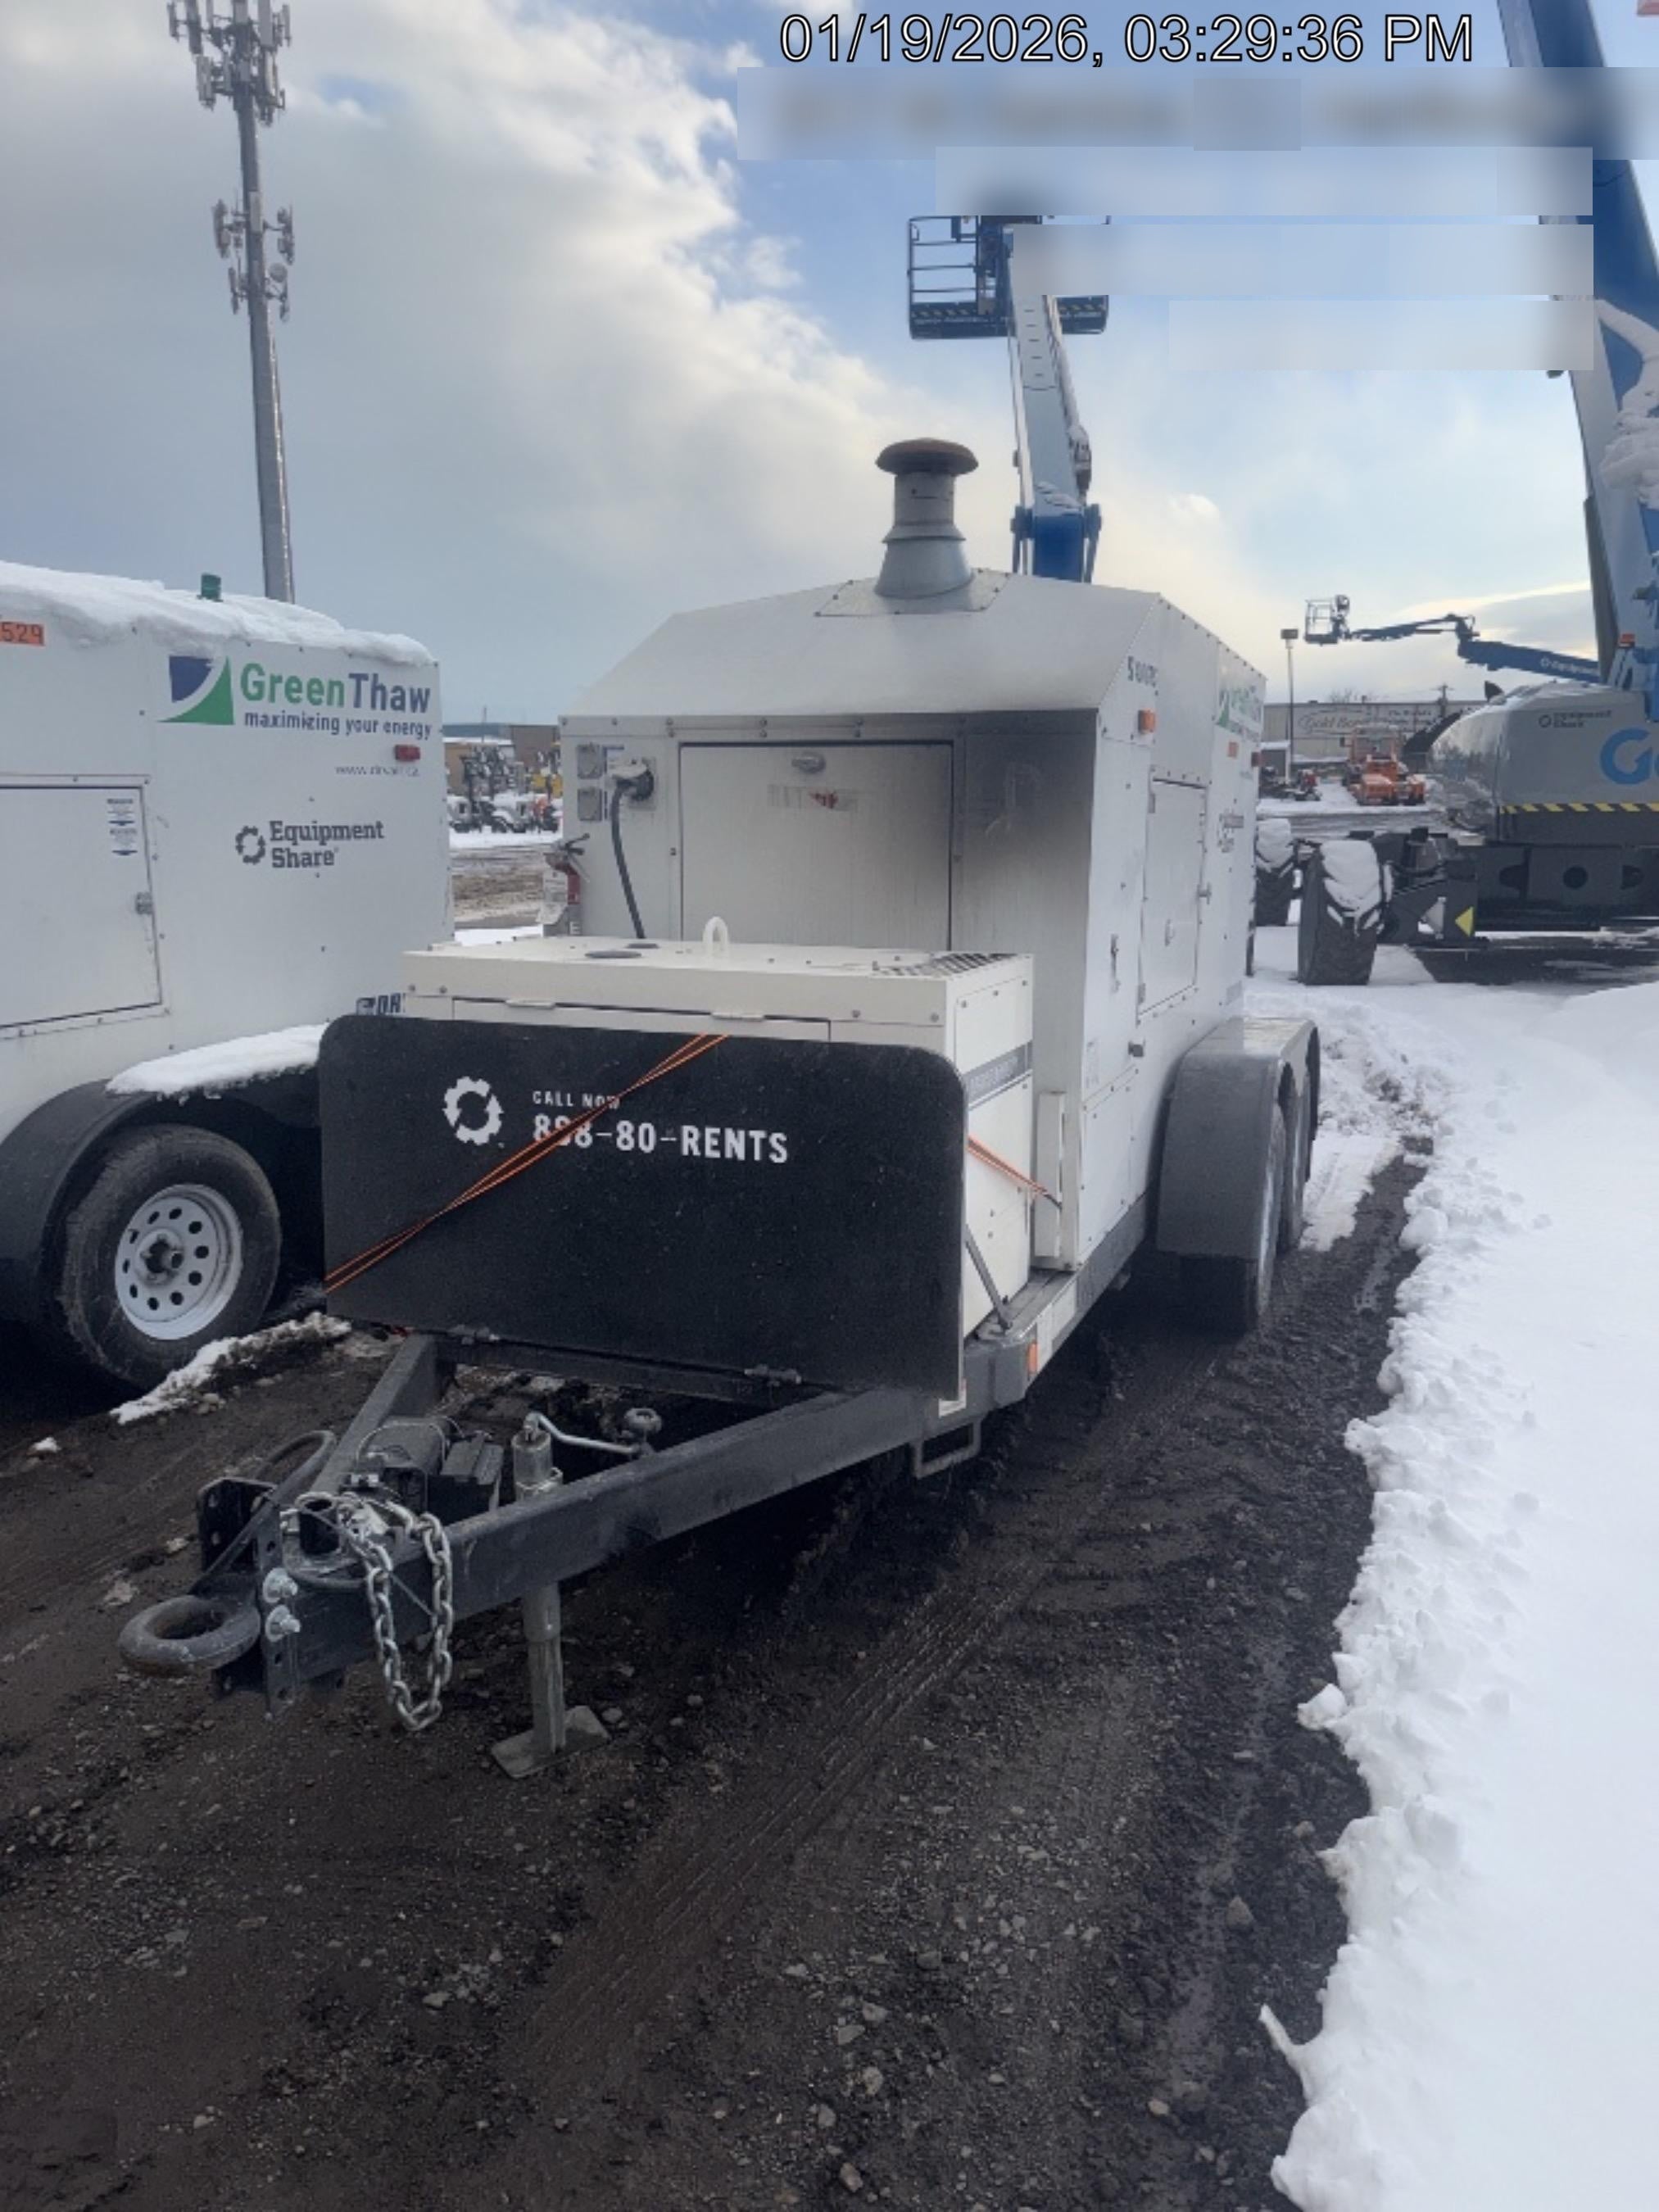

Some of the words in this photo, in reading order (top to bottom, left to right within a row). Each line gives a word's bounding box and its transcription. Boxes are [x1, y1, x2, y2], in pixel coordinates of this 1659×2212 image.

[240, 663, 431, 714] GreenThaw
[244, 710, 340, 736] maximizing
[346, 718, 379, 736] your
[383, 722, 433, 741] energy
[270, 820, 384, 845] Equipment
[272, 847, 335, 868] Share
[533, 1090, 574, 1107] CALL
[582, 1093, 620, 1109] NOW
[533, 1113, 788, 1163] 888-80-RENTS
